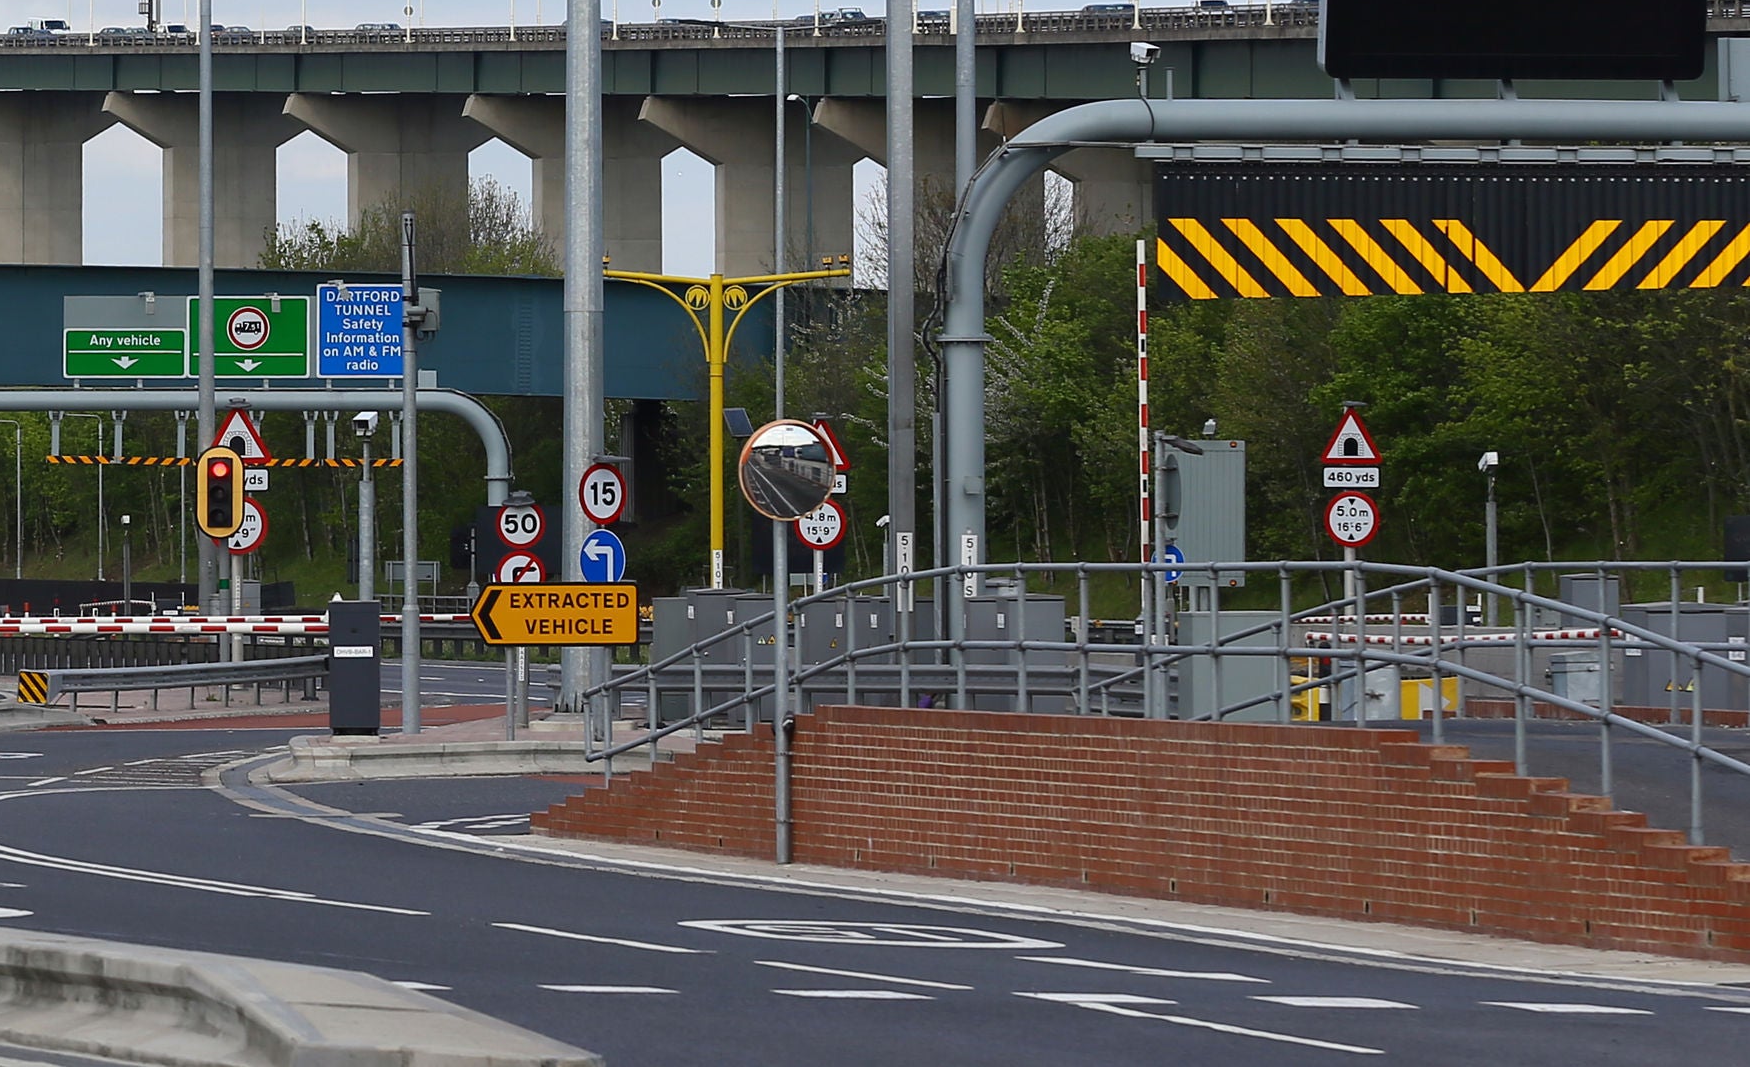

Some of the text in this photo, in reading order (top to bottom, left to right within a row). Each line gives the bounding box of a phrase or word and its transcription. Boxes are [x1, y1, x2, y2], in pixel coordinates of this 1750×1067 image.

[334, 304, 392, 316] TUNNEL
[342, 318, 384, 332] Safety
[89, 334, 161, 348] Any vehicle
[326, 331, 400, 343] Information
[323, 345, 402, 357] on AM & FM
[346, 359, 379, 371] radio
[1327, 472, 1375, 484] 460 yds
[590, 481, 616, 506] 15
[805, 512, 825, 522] 4.8
[1336, 505, 1358, 517] 5.0
[504, 513, 538, 534] 50
[510, 592, 630, 609] EXTRACTED
[525, 618, 614, 635] VEHICLE
